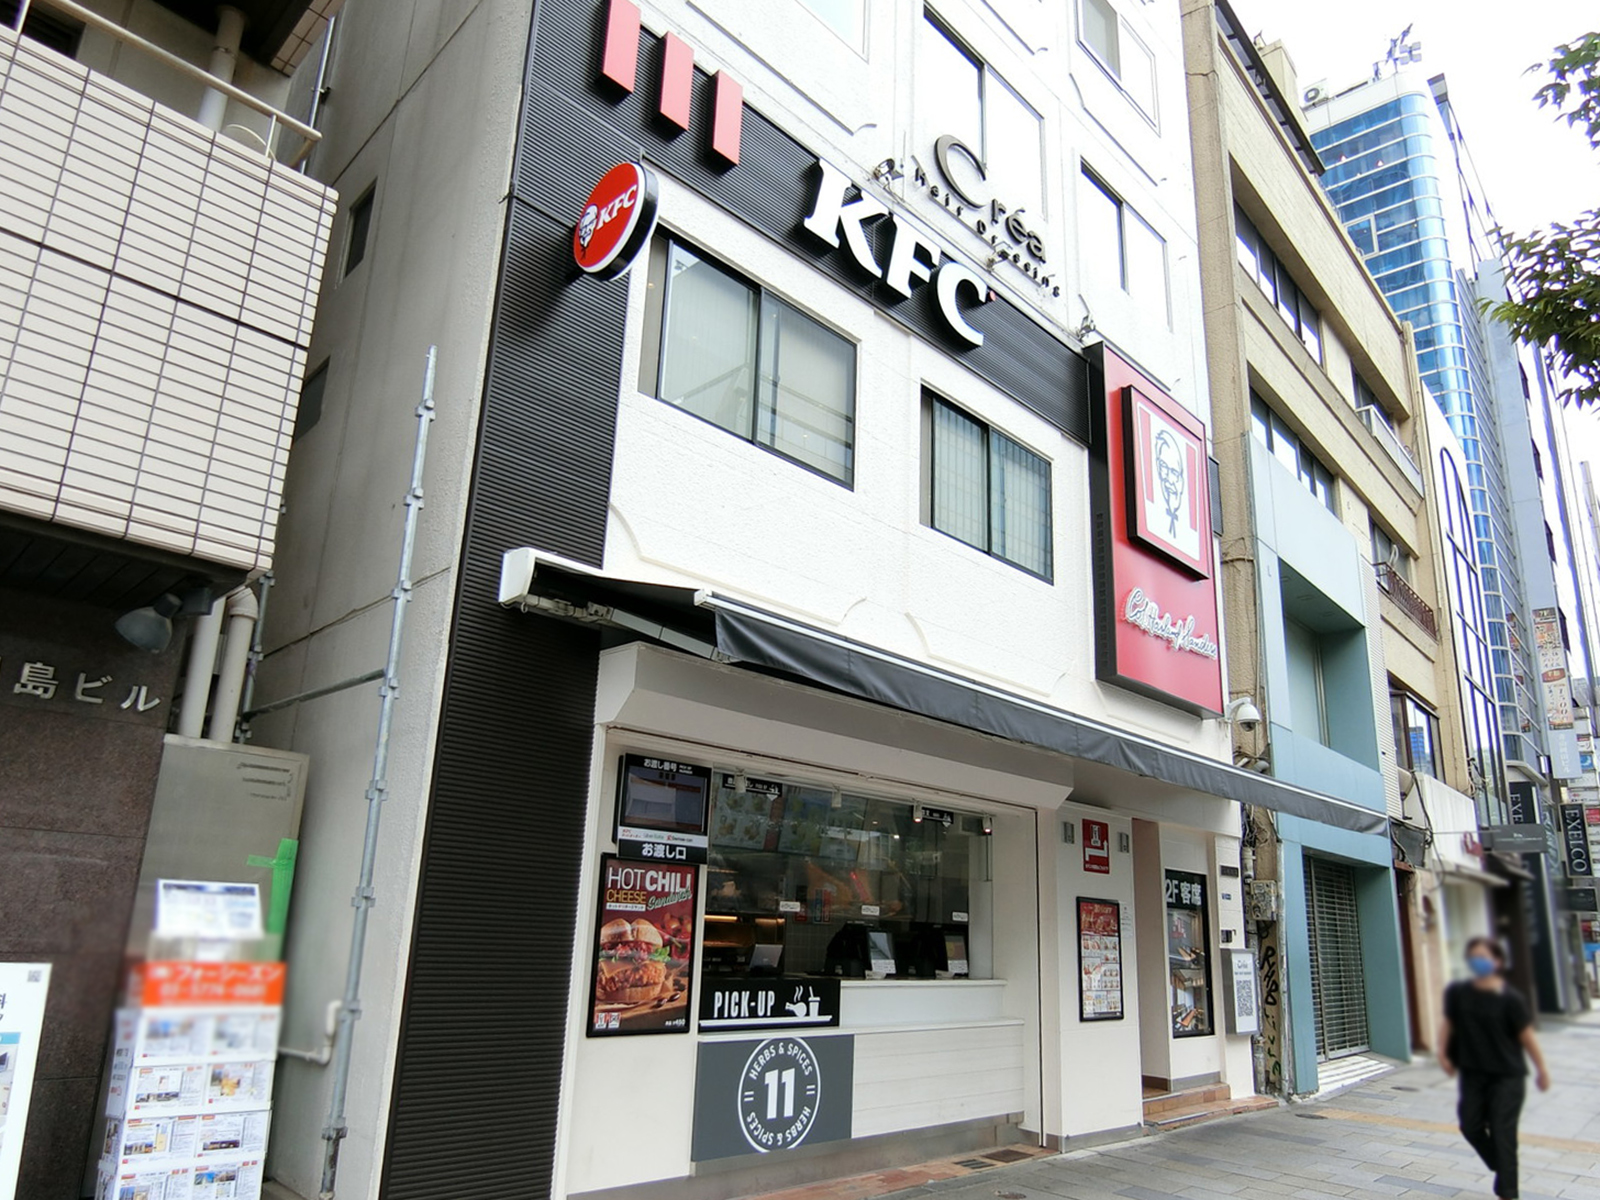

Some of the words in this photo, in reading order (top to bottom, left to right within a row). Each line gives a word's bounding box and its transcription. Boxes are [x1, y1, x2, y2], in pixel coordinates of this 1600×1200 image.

[596, 184, 637, 230] KFC
[934, 134, 1047, 264] Créa
[804, 156, 988, 346] KFC
[0, 656, 161, 712] 島ビル
[644, 758, 677, 773] お渡し番号
[642, 843, 687, 860] お渡し口
[1565, 809, 1588, 872] EXELCO
[607, 867, 645, 890] HOT
[645, 869, 692, 894] CHILI
[1165, 878, 1179, 903] 2F
[1180, 881, 1202, 906] 客席
[606, 889, 647, 904] CHEESE
[647, 888, 693, 911] Sandwich
[713, 990, 776, 1018] PICK-UP
[749, 1044, 777, 1081] HERBS
[778, 1042, 785, 1054] &
[787, 1043, 813, 1076] SPICES
[764, 1067, 796, 1120] 11
[747, 1111, 774, 1146] SPICES
[776, 1132, 783, 1146] &
[785, 1106, 811, 1142] HERBS
